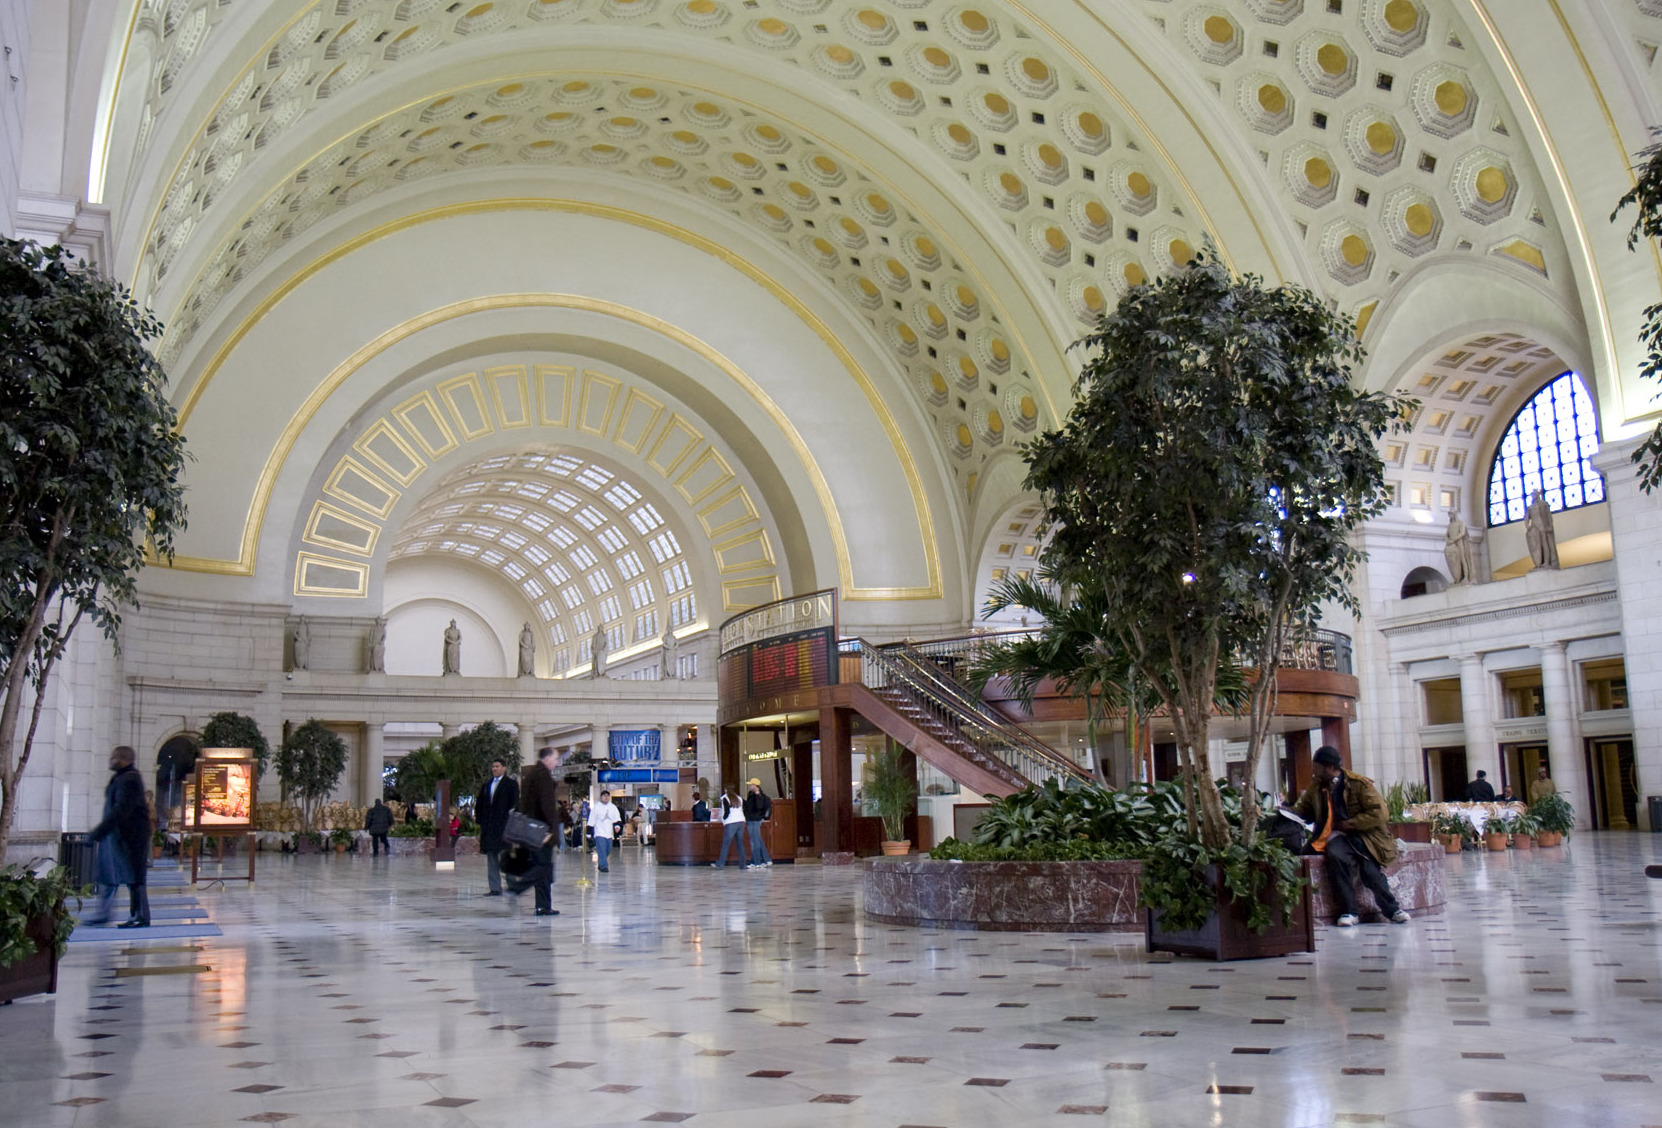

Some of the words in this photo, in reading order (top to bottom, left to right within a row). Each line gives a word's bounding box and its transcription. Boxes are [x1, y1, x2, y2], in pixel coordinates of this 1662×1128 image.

[747, 595, 832, 637] STATION
[612, 734, 629, 745] CITY
[632, 734, 642, 745] OF
[644, 734, 659, 745] THE
[612, 745, 659, 760] FUTURE
